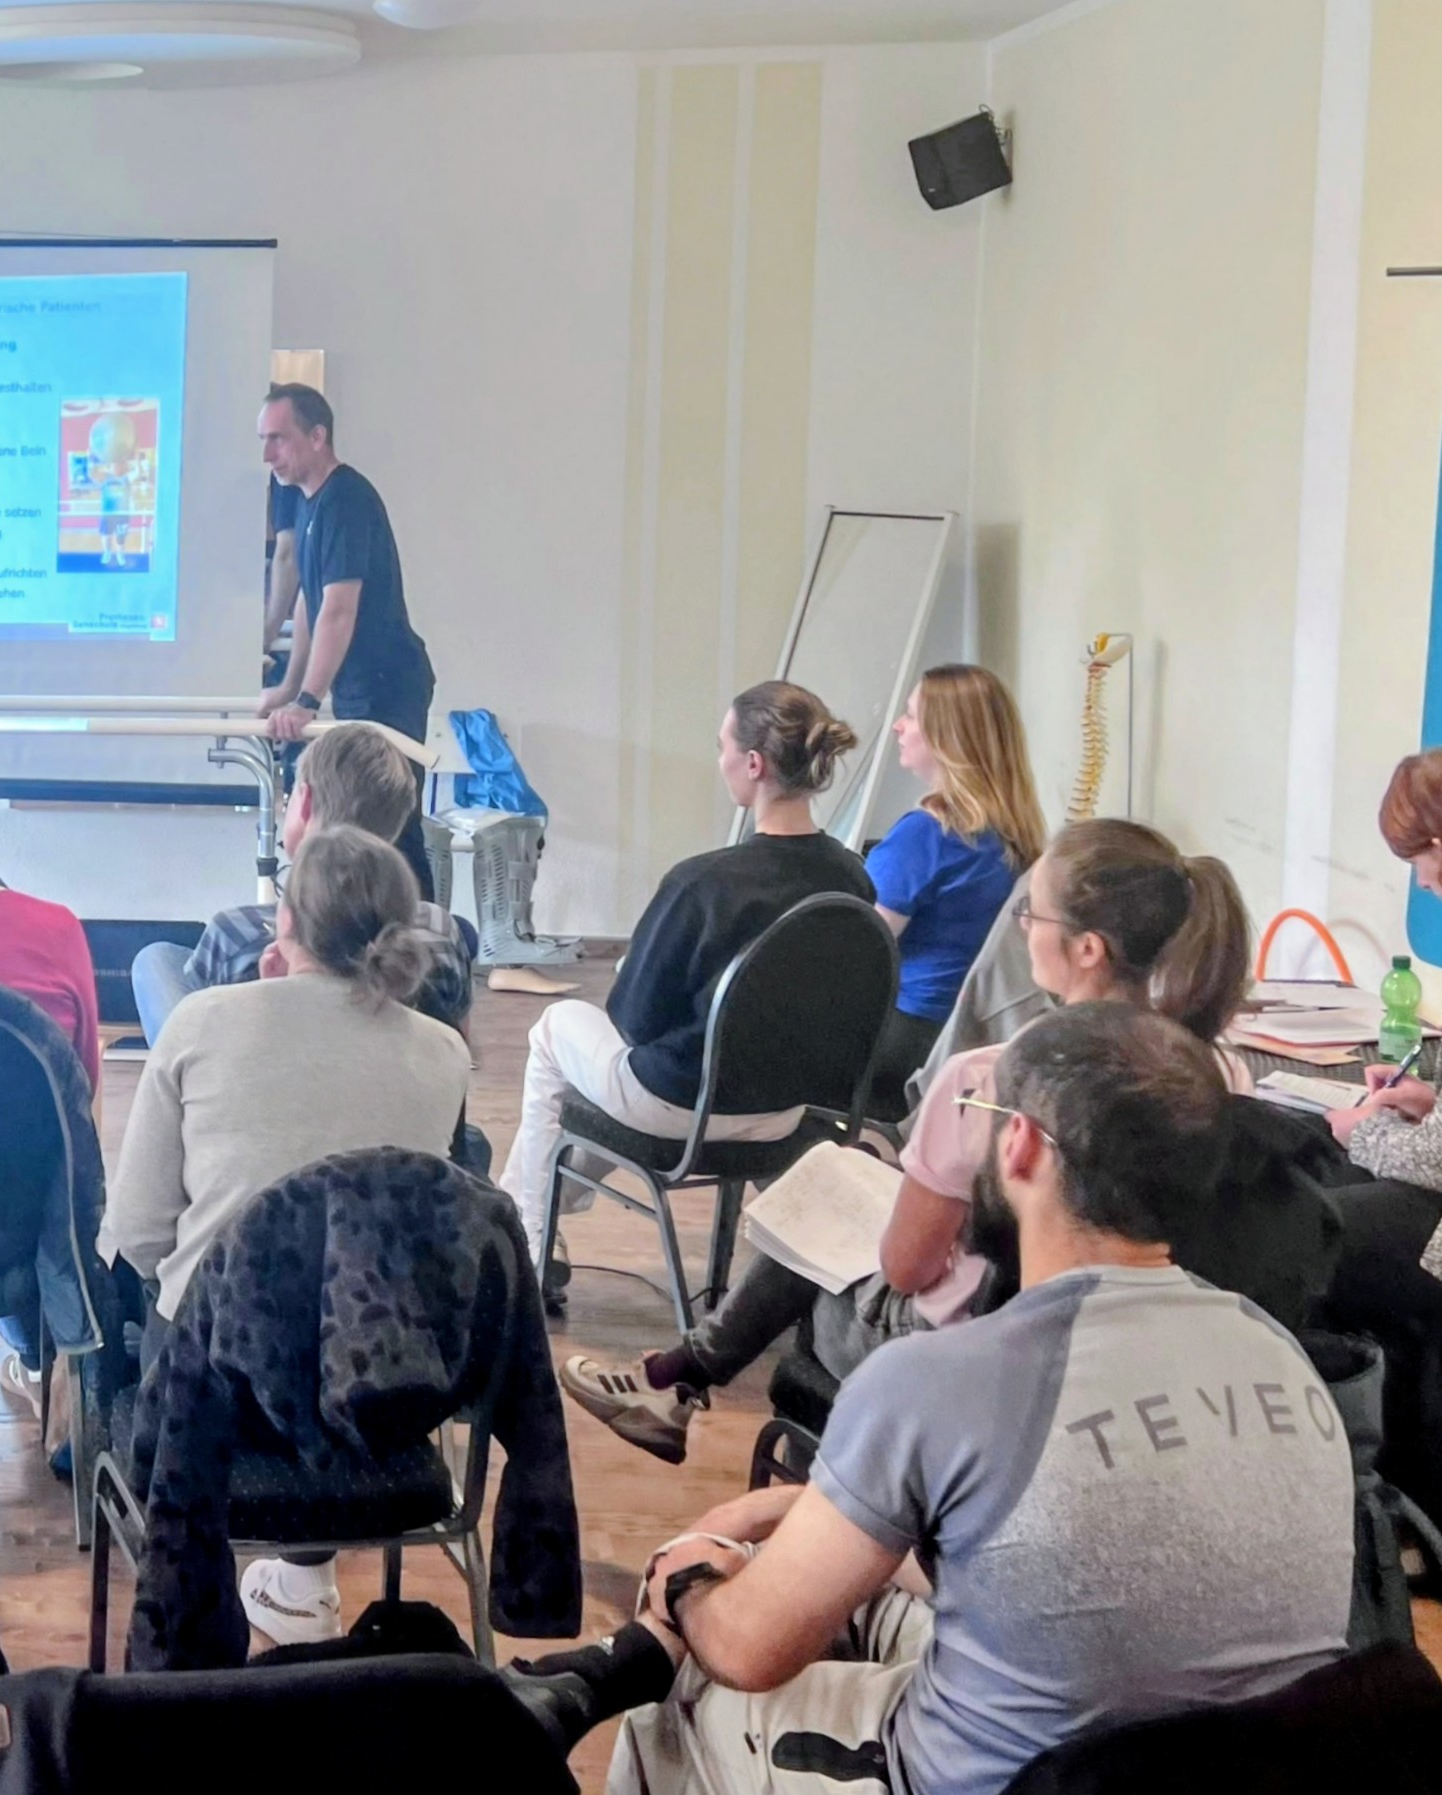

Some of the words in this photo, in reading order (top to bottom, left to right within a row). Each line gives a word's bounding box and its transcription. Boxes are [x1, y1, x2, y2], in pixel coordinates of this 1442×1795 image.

[20, 445, 47, 457] Bein
[5, 507, 42, 518] setzen
[1065, 1382, 1337, 1470] TEVEO
